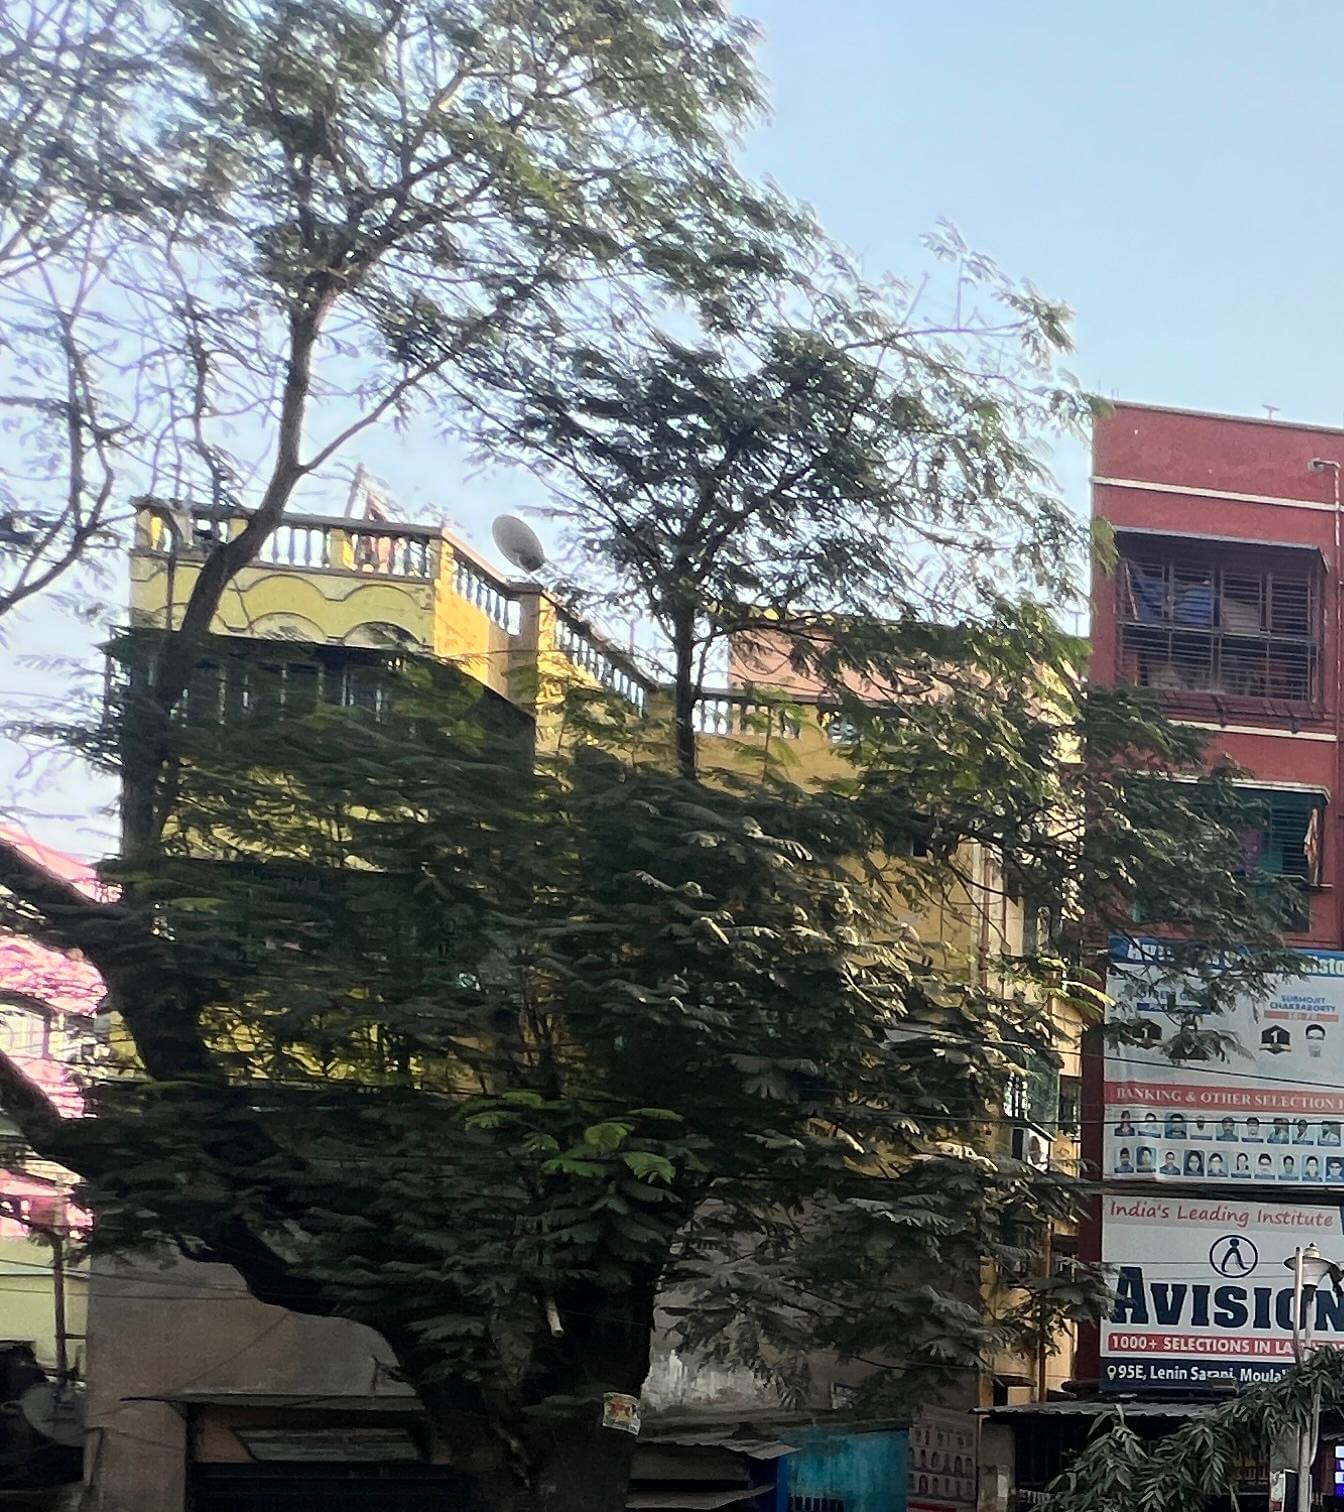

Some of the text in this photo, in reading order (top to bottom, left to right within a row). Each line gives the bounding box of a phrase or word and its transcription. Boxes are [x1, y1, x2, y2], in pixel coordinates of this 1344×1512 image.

[1270, 1030, 1278, 1043] 1
[1117, 1086, 1182, 1102] BANKING
[1185, 1090, 1196, 1102] &
[1200, 1091, 1251, 1105] OTHER
[1255, 1094, 1335, 1110] SELECTION
[1110, 1201, 1334, 1228] India's Leading Institute
[1112, 1335, 1157, 1350] 1000+
[1163, 1338, 1250, 1353] SELECTIONS
[1254, 1341, 1270, 1354] IN
[1118, 1364, 1147, 1381] 95E,
[1150, 1365, 1188, 1380] Lenin
